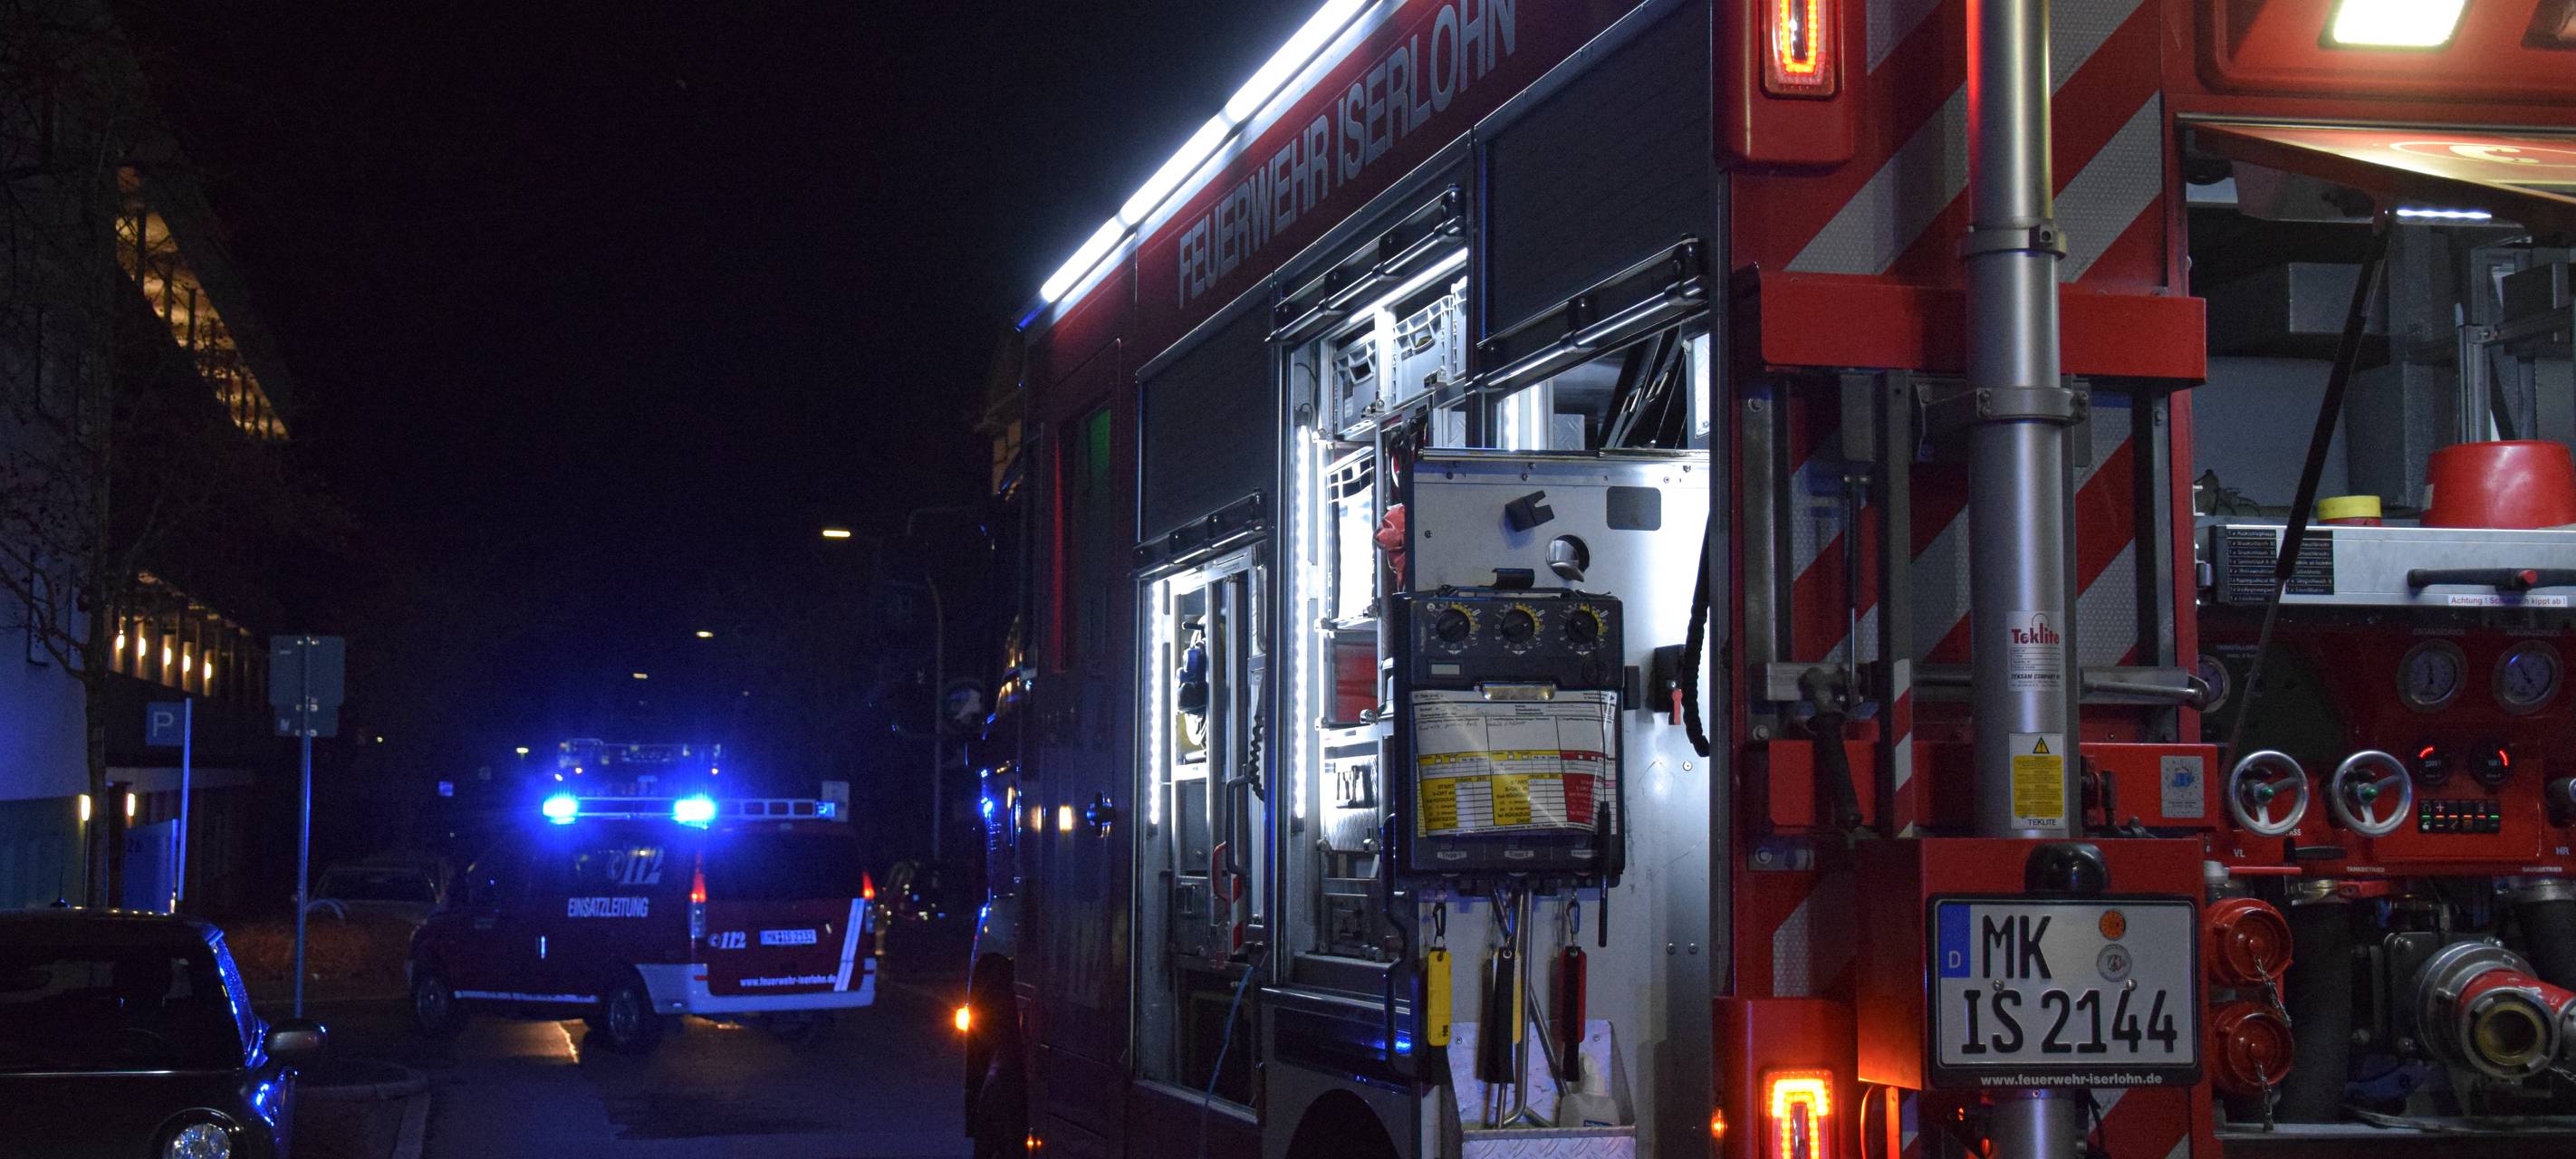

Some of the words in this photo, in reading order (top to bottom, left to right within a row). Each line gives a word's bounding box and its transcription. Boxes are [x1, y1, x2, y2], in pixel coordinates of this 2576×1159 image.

[1179, 115, 1329, 309] FEUERWEHR
[1338, 0, 1515, 187] ISERLOHN
[2451, 596, 2483, 606] Achtung
[2011, 622, 2060, 645] Teklite
[153, 711, 175, 737] P
[2233, 848, 2246, 858] VL
[2555, 846, 2570, 856] HR
[621, 848, 665, 885] 112
[568, 896, 649, 918] EINSATZLEITUNG
[719, 931, 747, 949] 112
[1982, 915, 2052, 980] MK
[1948, 950, 1961, 969] D
[1962, 989, 2023, 1054] IS
[2040, 989, 2177, 1054] 2144
[1980, 1073, 2163, 1086] www.feuerwehr-iserlohn.de
